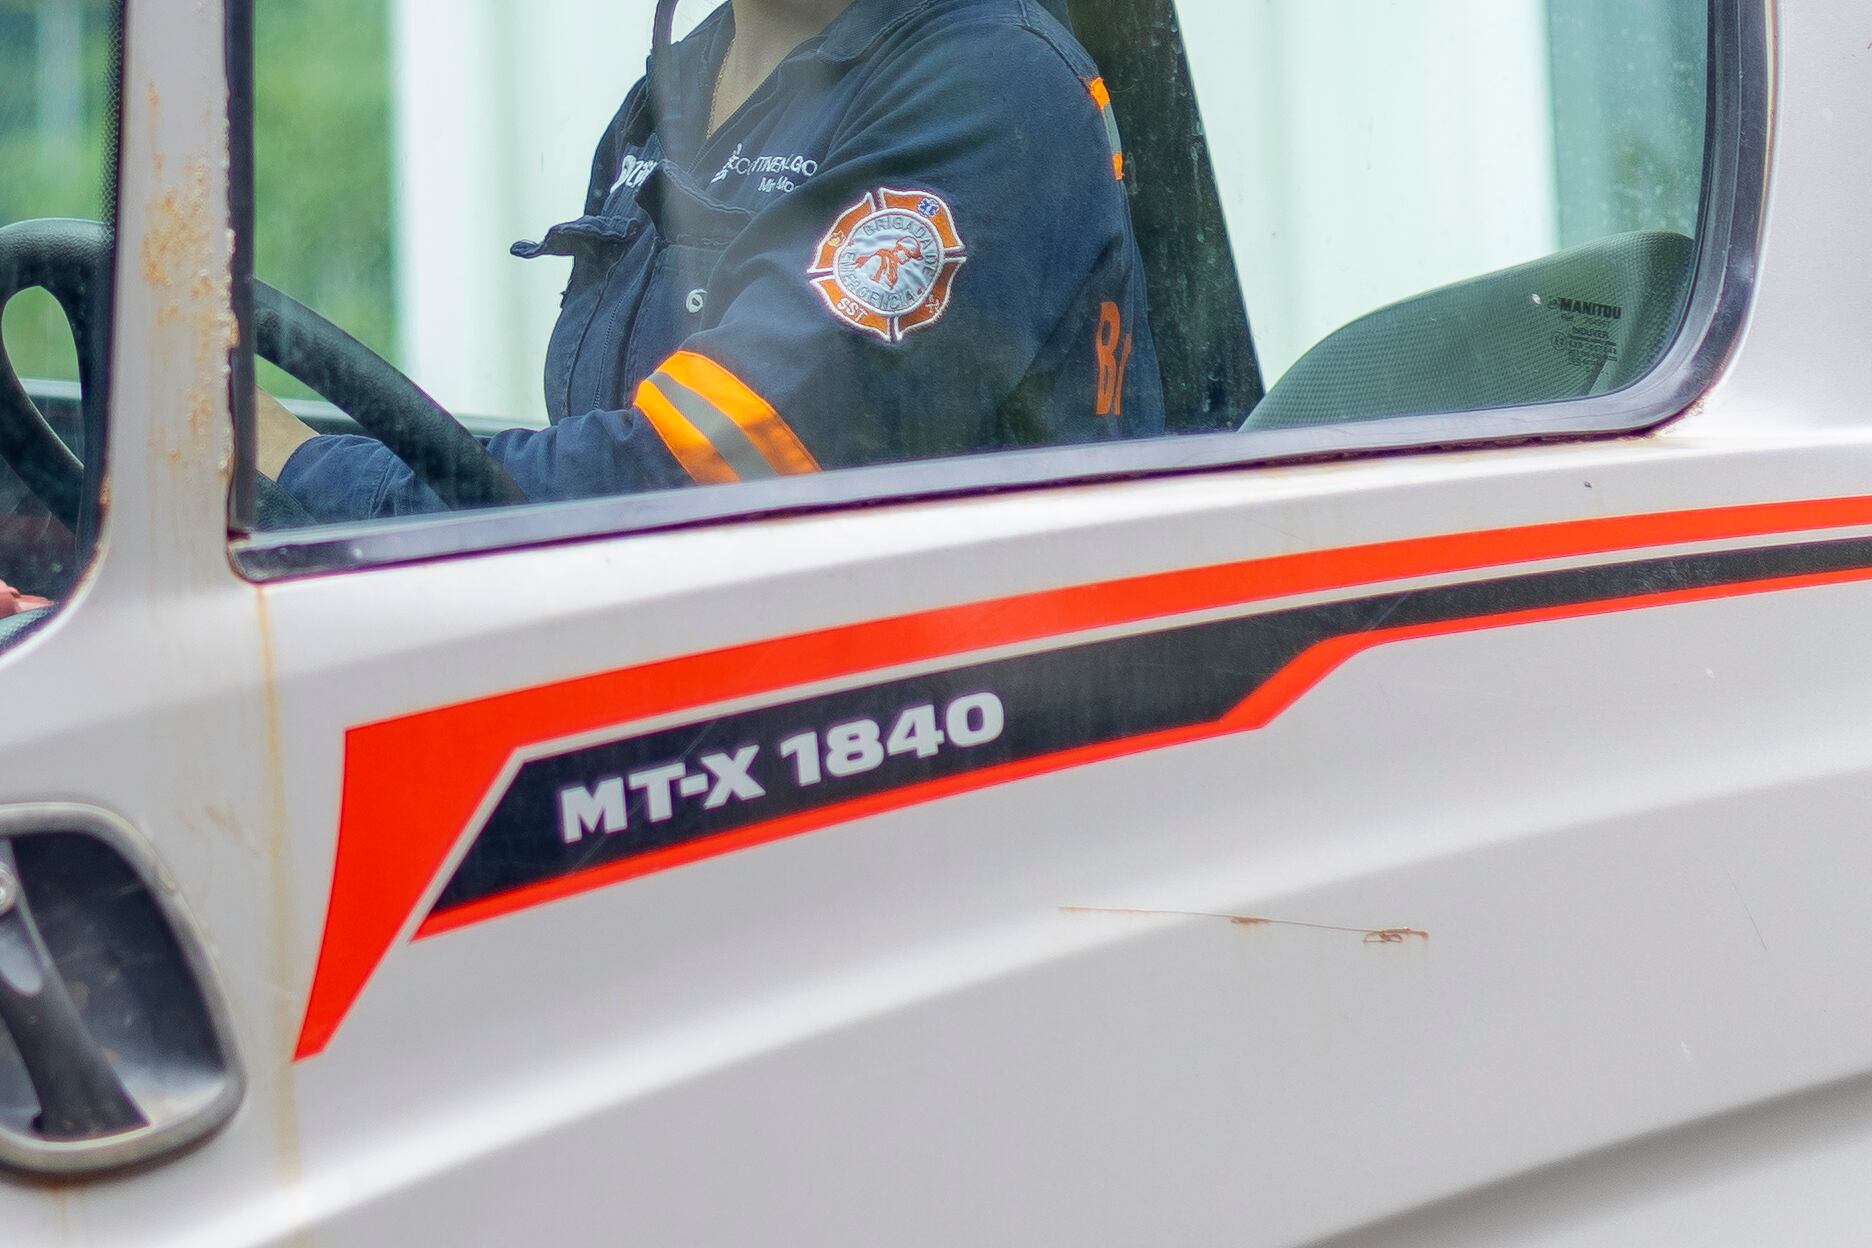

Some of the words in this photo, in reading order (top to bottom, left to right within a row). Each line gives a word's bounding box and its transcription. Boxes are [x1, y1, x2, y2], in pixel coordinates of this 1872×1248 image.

[862, 216, 934, 250] BRIGADA
[836, 296, 868, 322] SST
[1558, 297, 1621, 319] MANITOU
[559, 743, 766, 843] MT-X
[781, 691, 1004, 786] 1840
